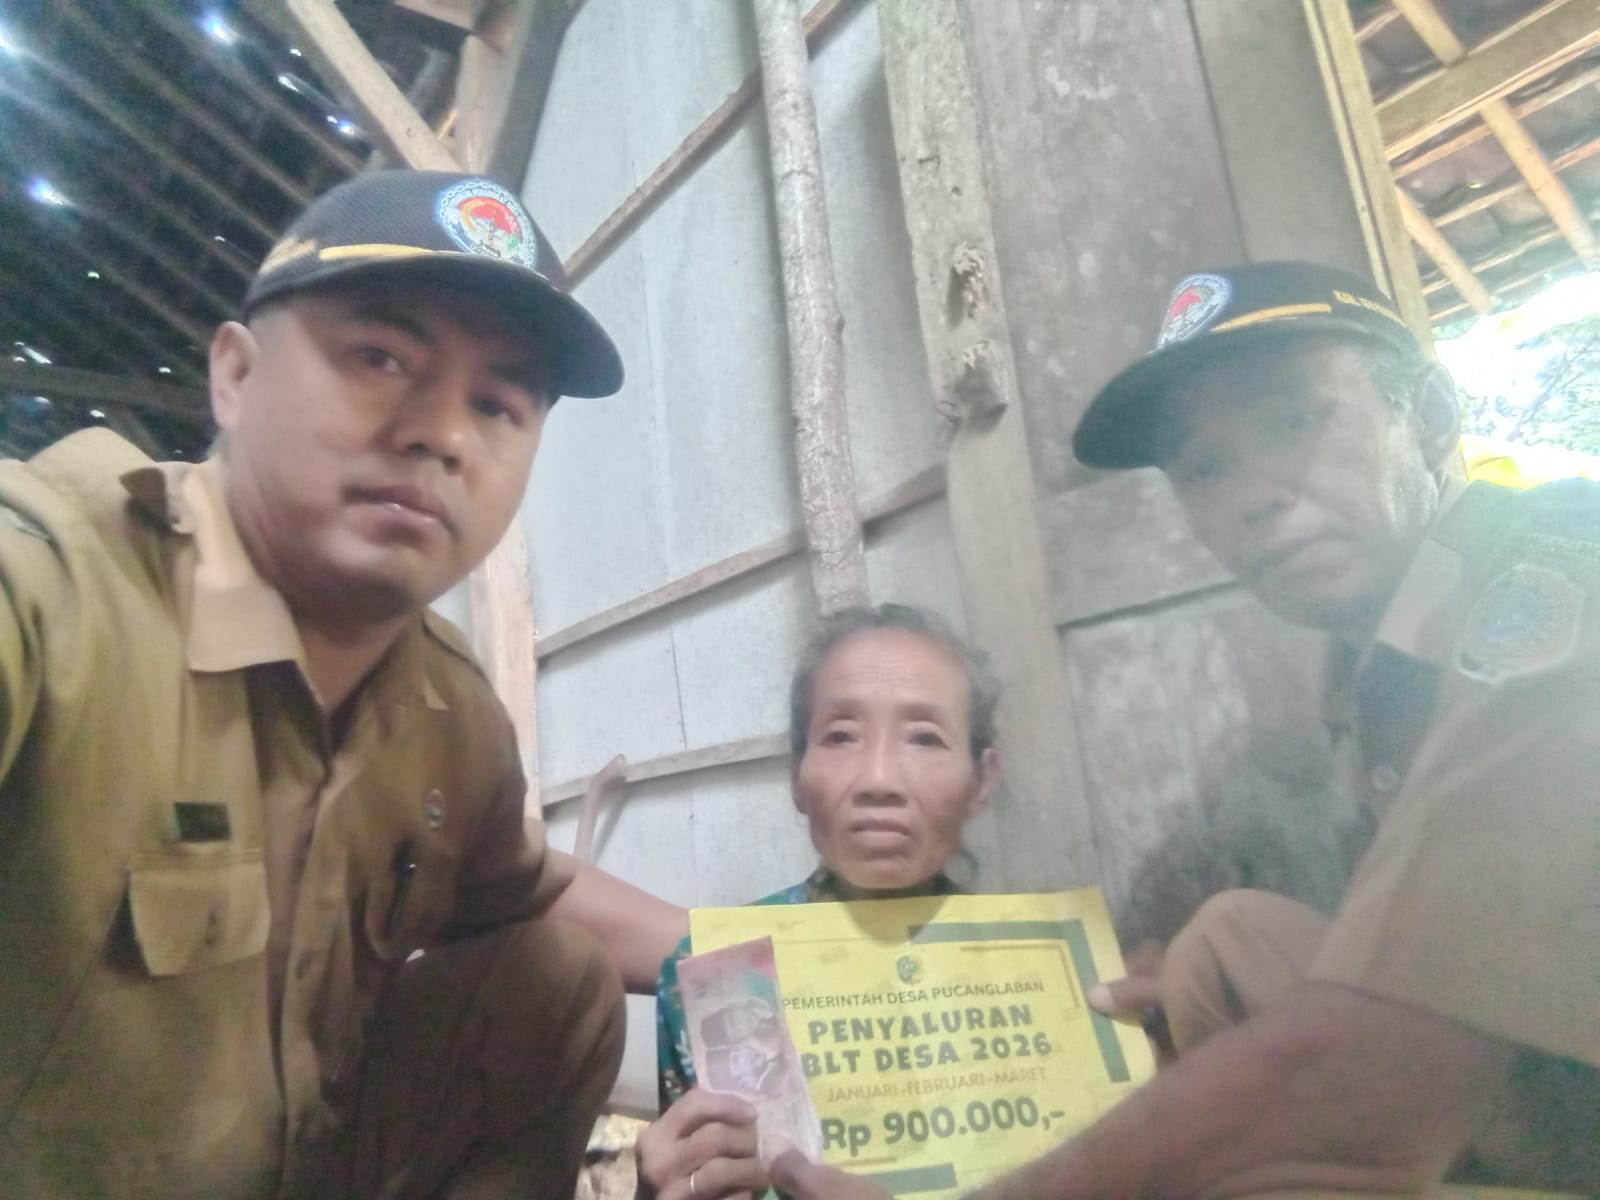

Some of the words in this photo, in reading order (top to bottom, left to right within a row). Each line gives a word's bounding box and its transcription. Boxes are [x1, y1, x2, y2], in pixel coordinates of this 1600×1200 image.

[783, 993, 883, 1010] PEMERINTAH
[887, 989, 928, 1004] DESA
[932, 981, 1045, 999] PUCANGLABAN
[808, 1004, 1033, 1045] PENYALURAN
[800, 1049, 861, 1079] BLT
[874, 1040, 960, 1073] DESA
[970, 1031, 1052, 1060] 2026
[820, 1117, 871, 1157] Rp
[883, 1096, 1065, 1145] 900.000,-
